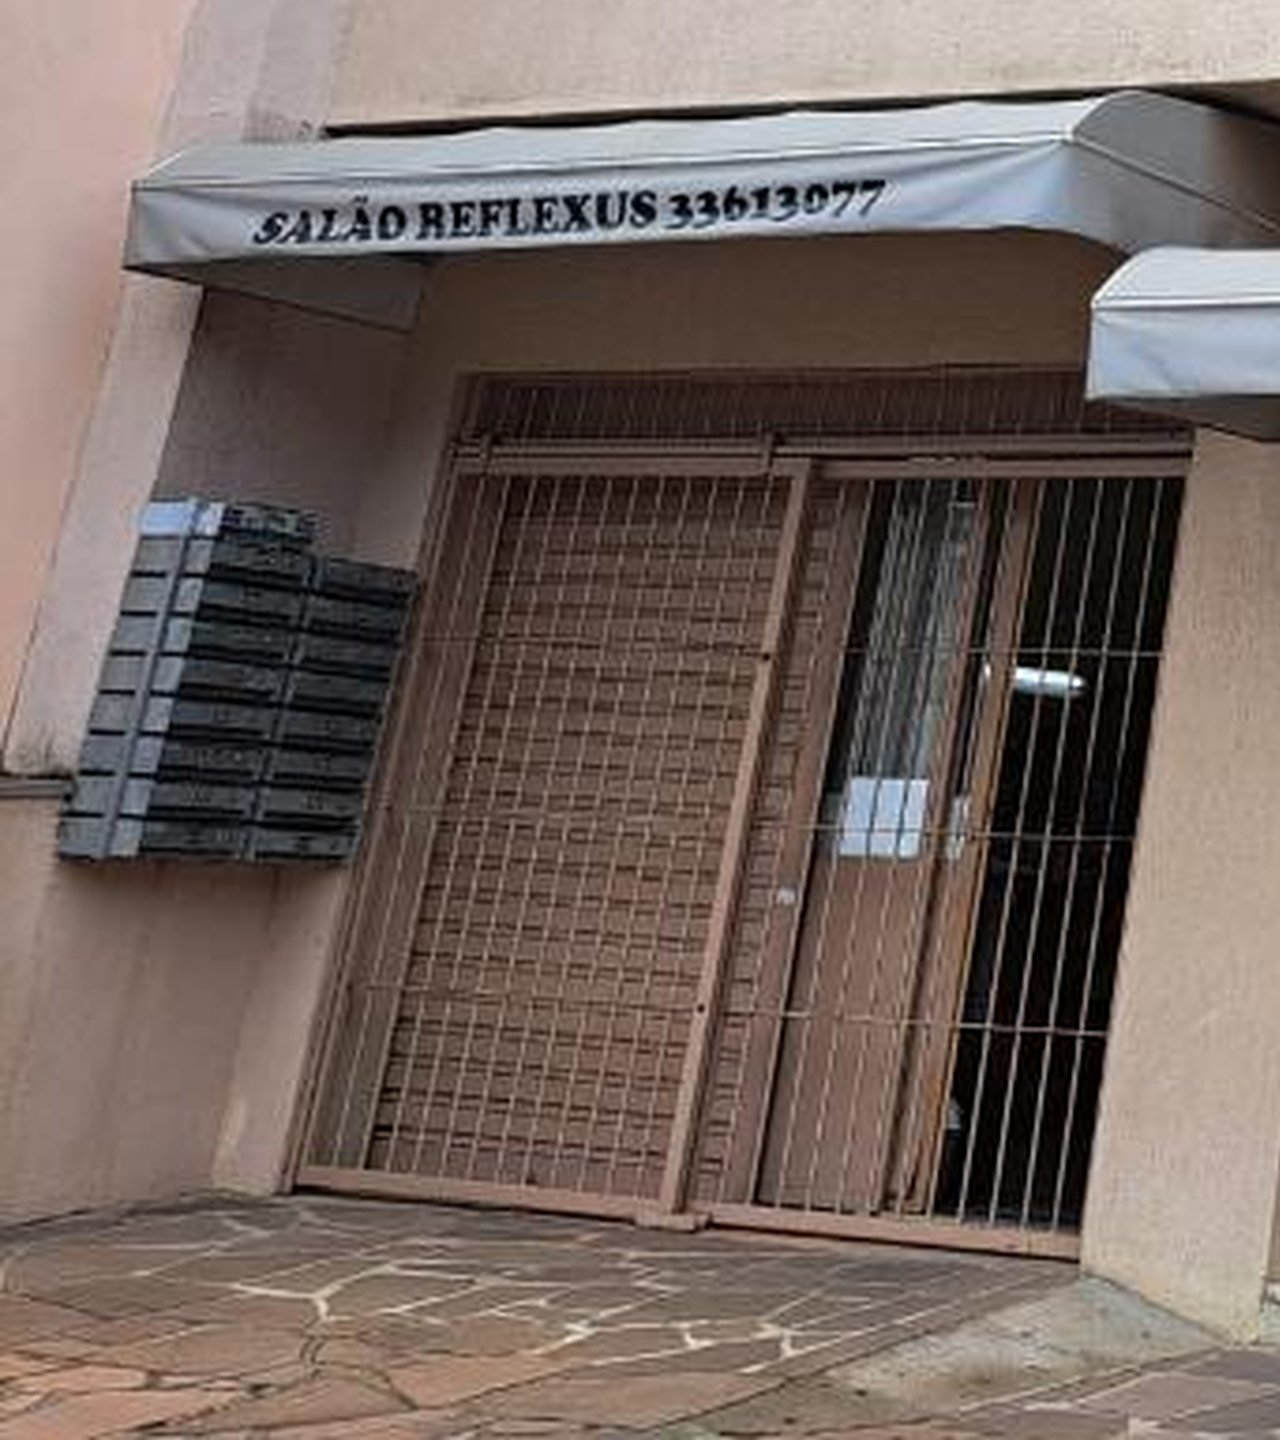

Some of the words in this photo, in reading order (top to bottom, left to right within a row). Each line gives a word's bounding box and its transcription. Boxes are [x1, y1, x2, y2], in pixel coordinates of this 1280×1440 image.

[253, 196, 408, 244] SALÃO
[415, 190, 658, 239] REFLEXUS
[662, 179, 887, 229] 33613077
